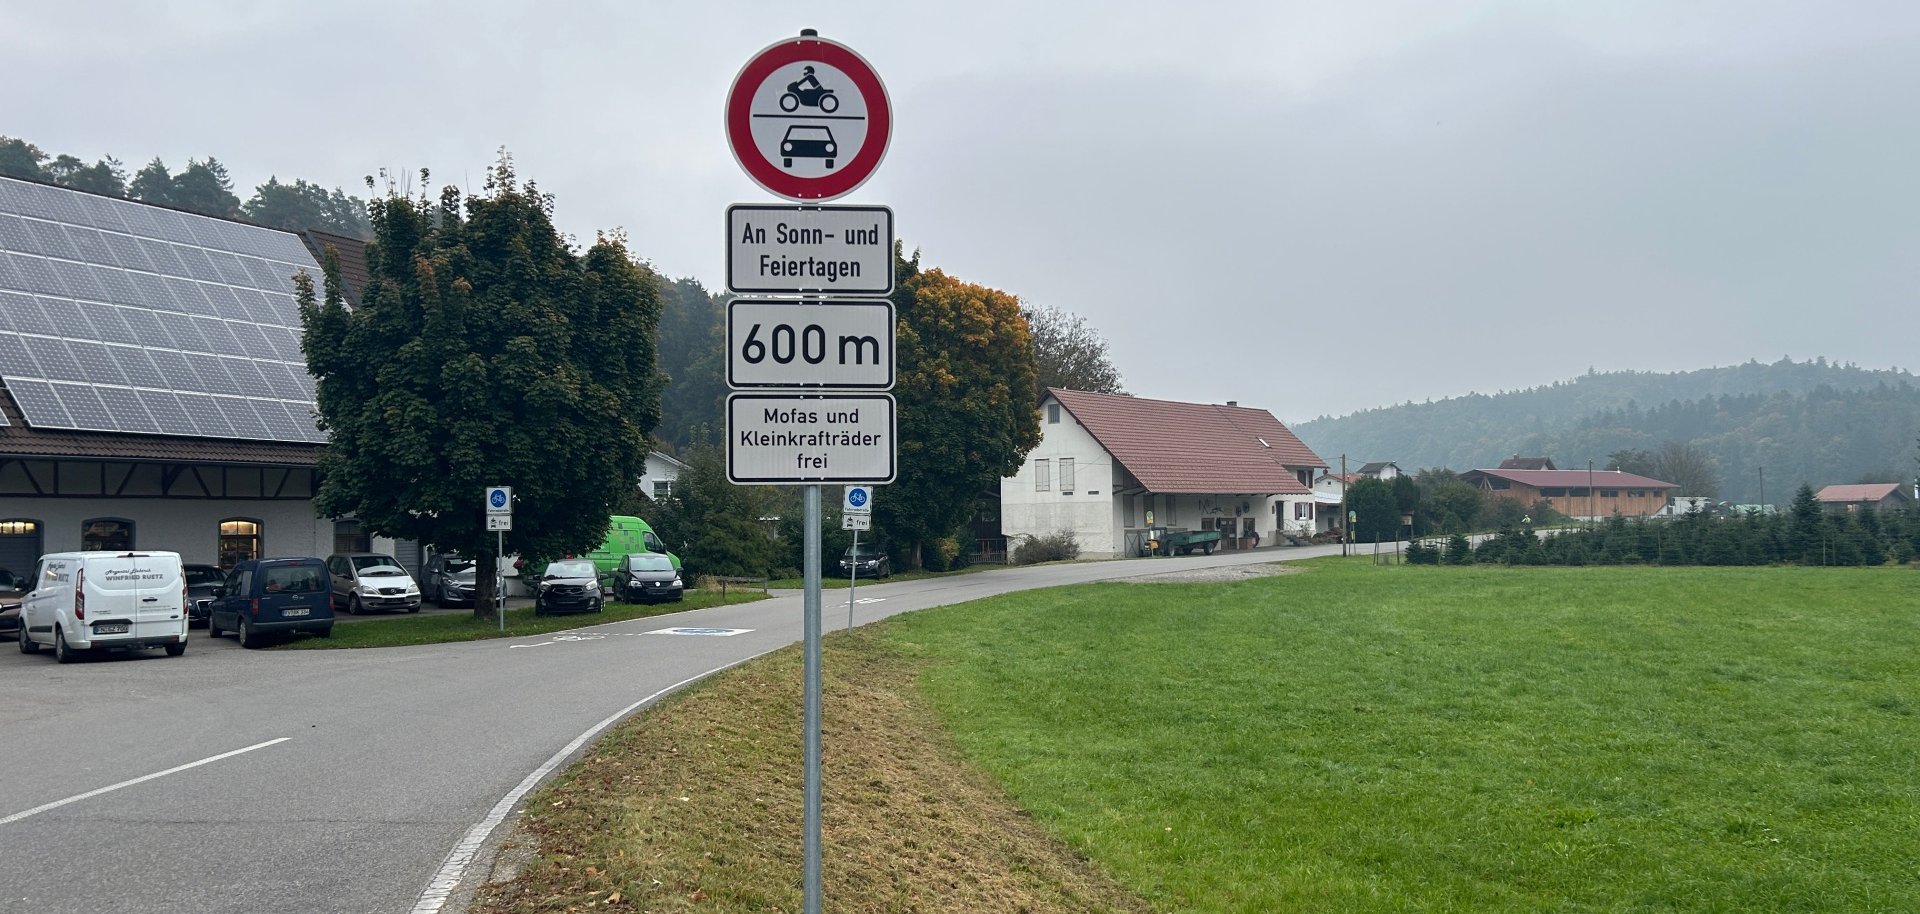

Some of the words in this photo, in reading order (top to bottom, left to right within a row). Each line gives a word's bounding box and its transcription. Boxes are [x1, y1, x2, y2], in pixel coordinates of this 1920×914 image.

[741, 222, 766, 244] An
[776, 222, 835, 245] Sonn-
[845, 223, 879, 246] und
[760, 254, 861, 283] Feiertagen
[741, 323, 826, 365] 600
[838, 335, 880, 366] m
[764, 408, 818, 424] Mofas
[826, 408, 859, 424] und
[741, 430, 882, 447] Kleinkrafträder
[796, 453, 828, 469] frei
